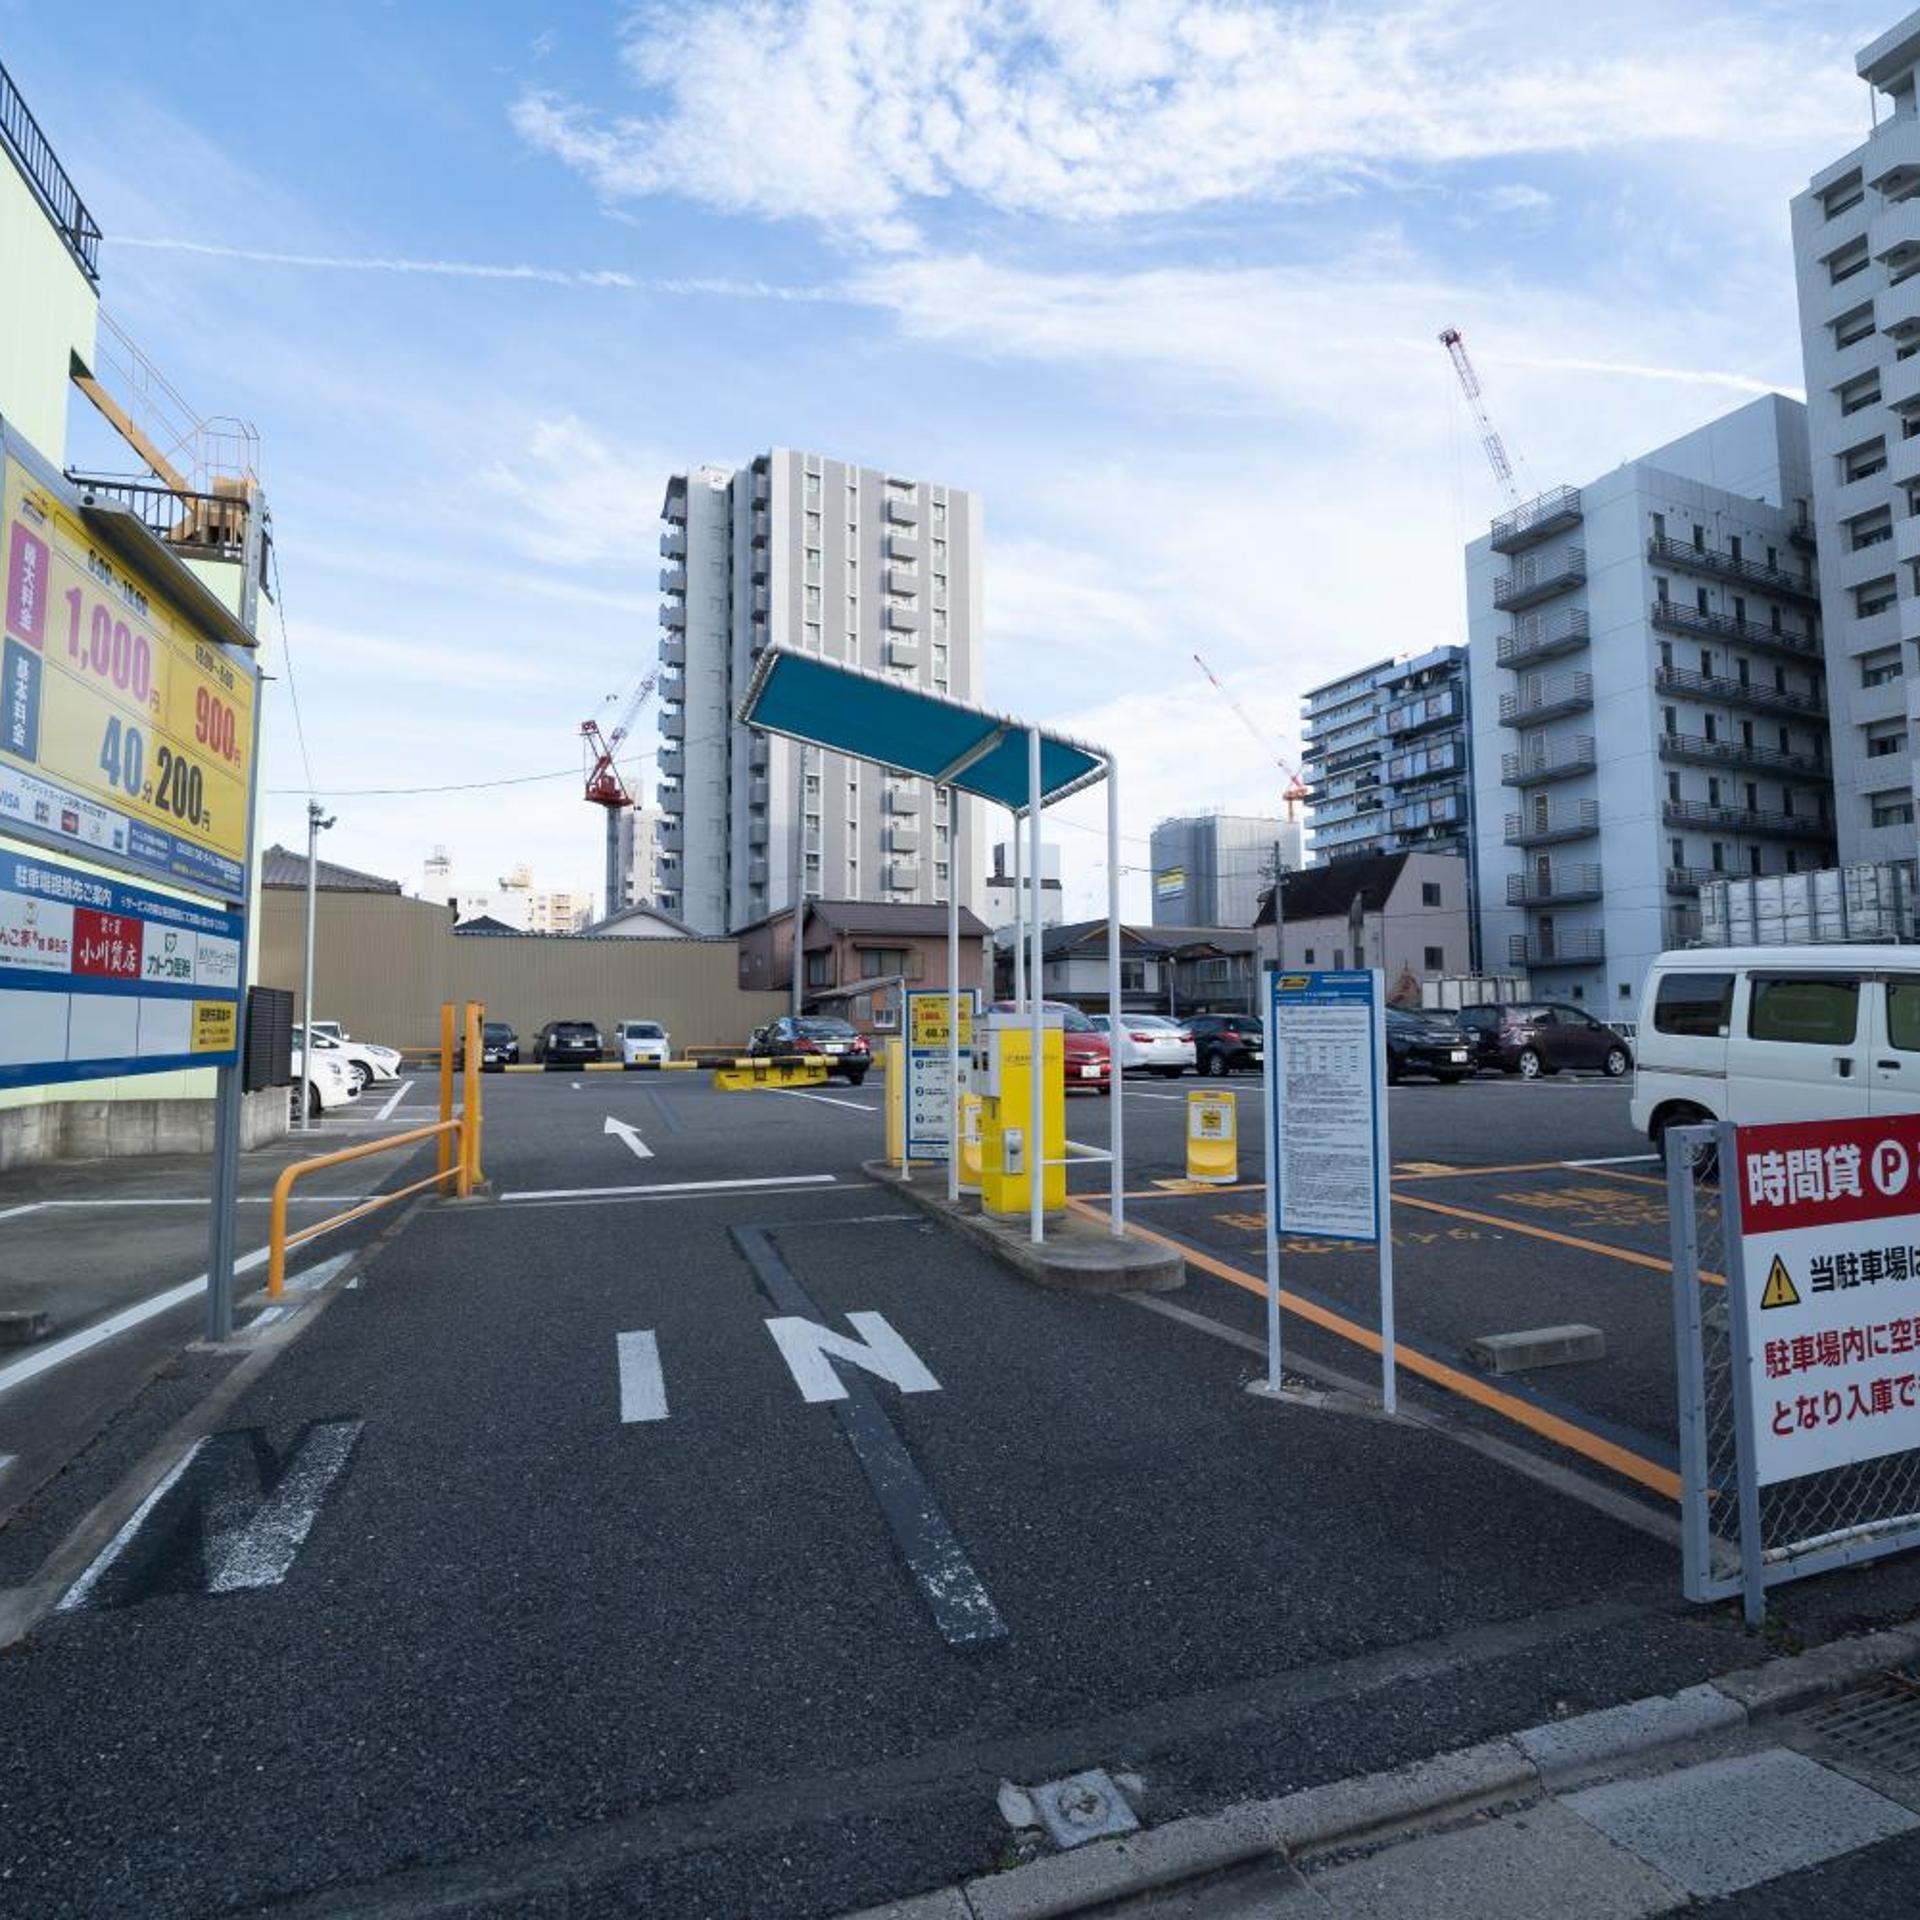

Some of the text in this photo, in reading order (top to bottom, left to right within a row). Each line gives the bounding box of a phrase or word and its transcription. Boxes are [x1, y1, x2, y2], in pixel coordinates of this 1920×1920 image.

[79, 937, 136, 972] 小川質店
[1746, 1143, 1863, 1207] 時間貸
[1772, 1373, 1920, 1436] となり入庫で
